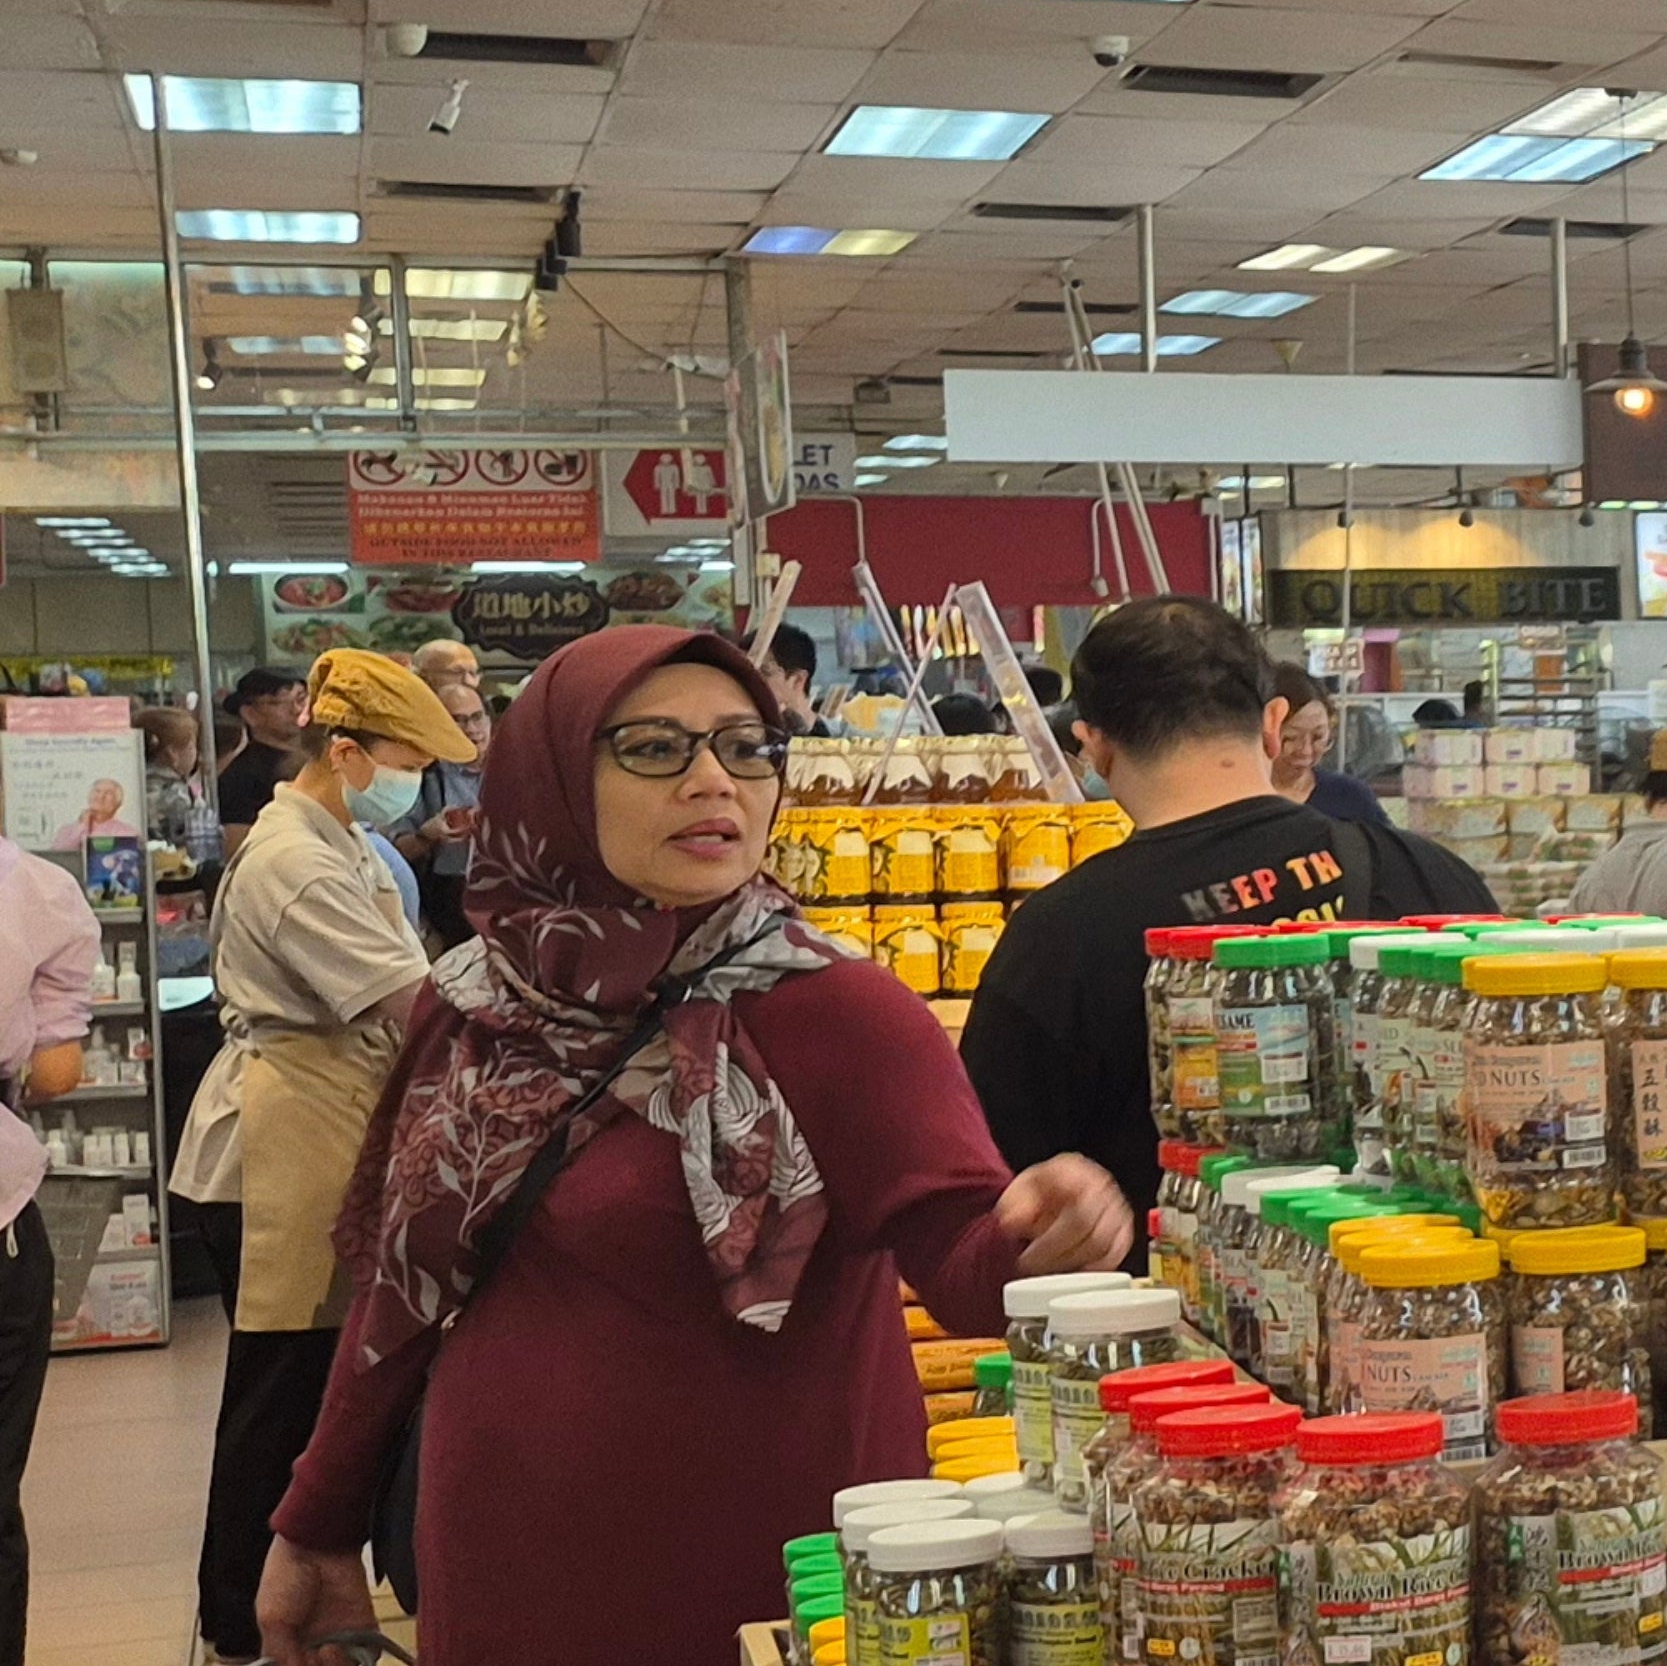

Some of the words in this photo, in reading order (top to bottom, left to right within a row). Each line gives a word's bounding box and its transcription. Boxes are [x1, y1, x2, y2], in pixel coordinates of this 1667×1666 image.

[1302, 578, 1476, 623] QUICK
[1502, 577, 1607, 615] BITE
[1180, 866, 1279, 922] KEEP
[1495, 1069, 1541, 1087] NUTS
[1366, 1363, 1413, 1383] NUTS
[1559, 1547, 1629, 1569] Brown
[1185, 1560, 1275, 1581] Cracker
[1317, 1581, 1393, 1603] Brown
